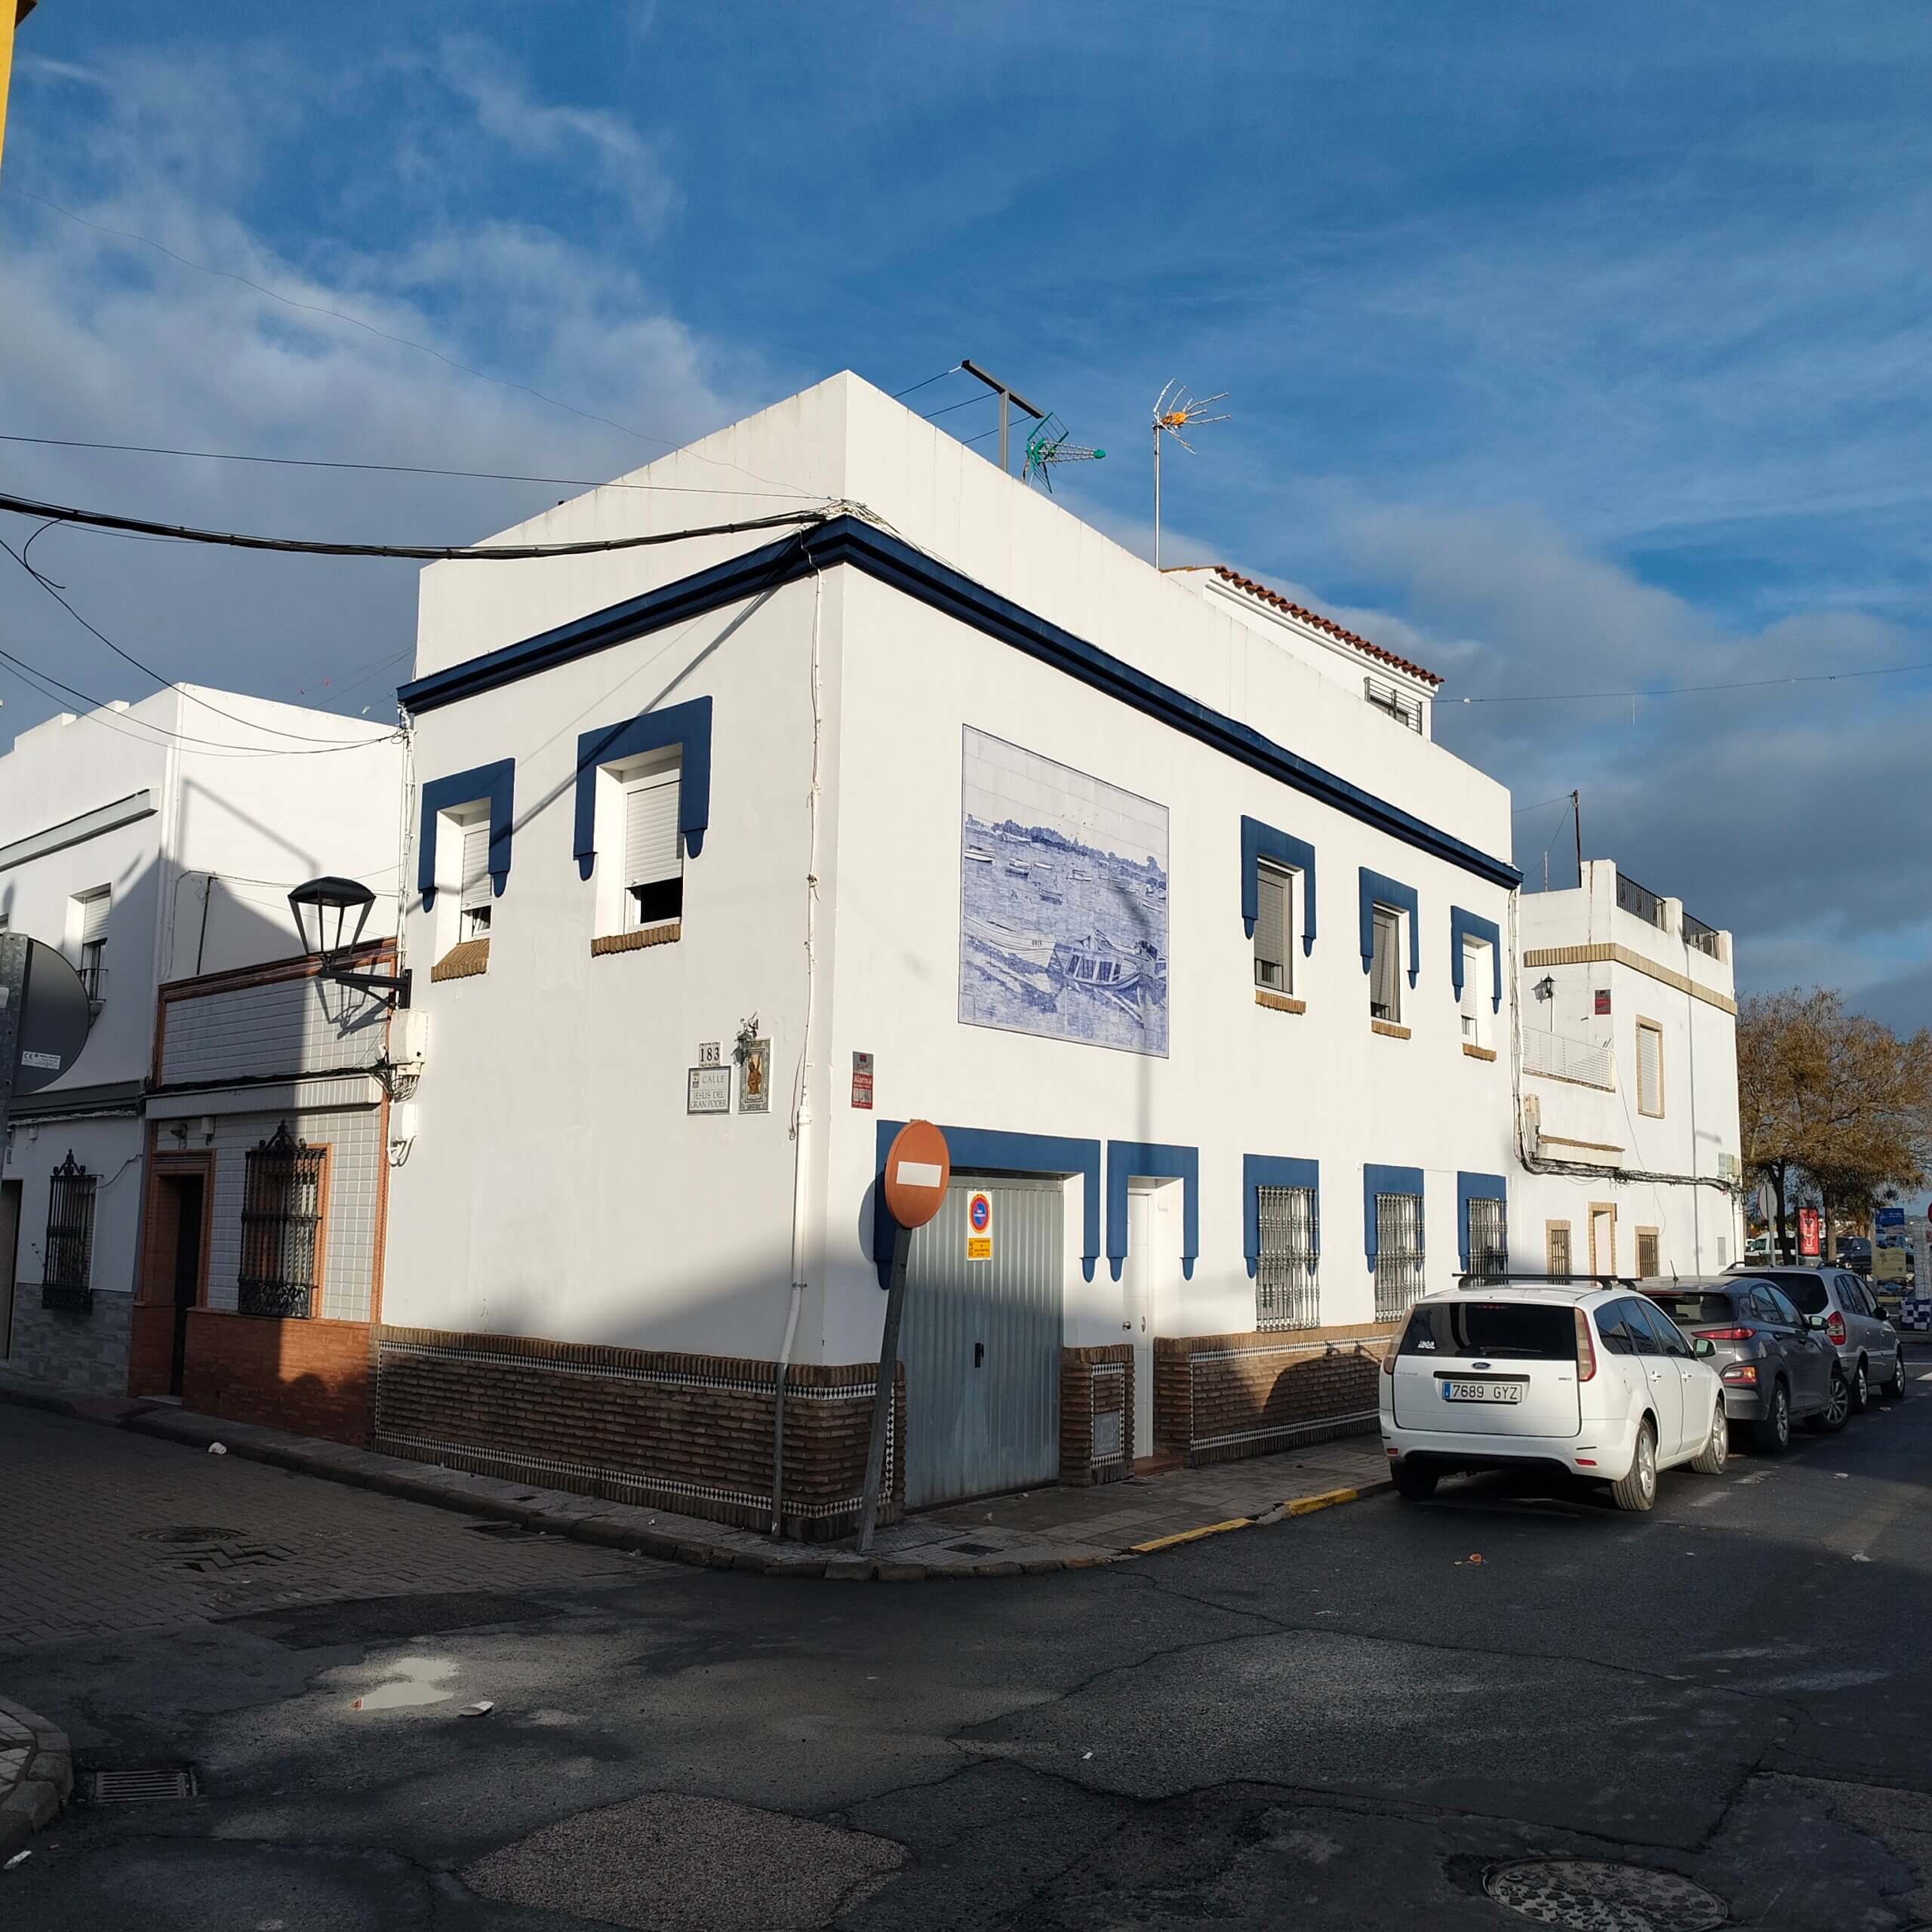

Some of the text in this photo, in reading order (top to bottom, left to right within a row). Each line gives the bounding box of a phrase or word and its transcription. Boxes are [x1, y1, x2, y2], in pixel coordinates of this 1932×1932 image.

[700, 1047, 720, 1063] 183
[702, 1075, 725, 1084] CALLE
[713, 1091, 724, 1099] DEL
[1453, 1384, 1518, 1400] 7689 GYZ
